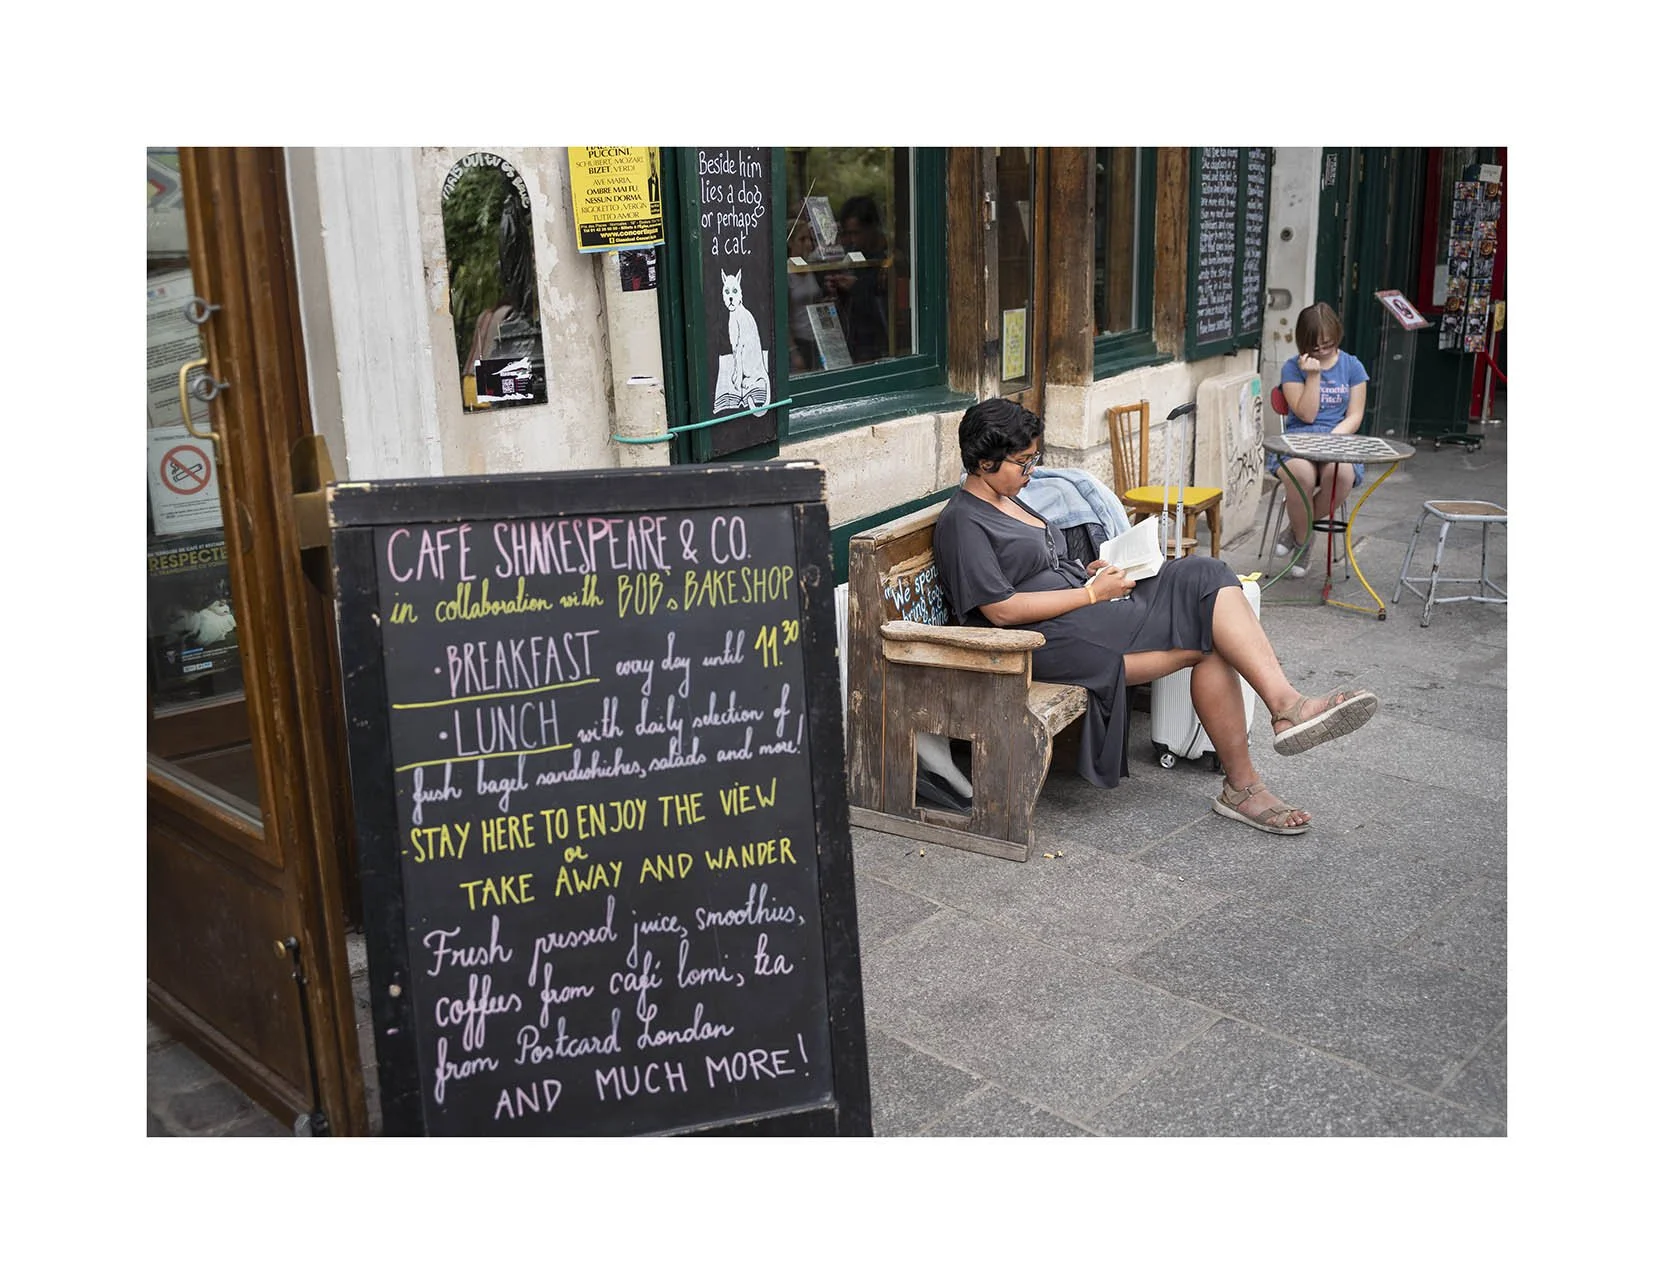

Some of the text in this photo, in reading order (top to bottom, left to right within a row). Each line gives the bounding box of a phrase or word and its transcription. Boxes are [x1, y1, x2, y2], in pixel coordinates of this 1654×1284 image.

[586, 187, 611, 196] OMBRE
[699, 150, 763, 178] Beside him
[585, 196, 612, 205] NESSUN
[701, 177, 765, 219] lies a dog
[701, 205, 758, 236] or perhaps
[711, 230, 752, 256] a cat.
[493, 516, 672, 578] SHAKESPEARE
[679, 518, 699, 564] &
[711, 516, 752, 564] CO.
[390, 591, 418, 624] in
[435, 575, 553, 622] collaboration
[560, 573, 604, 609] with
[914, 565, 939, 595] spen
[446, 630, 600, 698] BREAKFAST
[616, 658, 654, 696] every
[661, 632, 691, 698] day
[702, 630, 745, 667] until
[454, 683, 791, 756] LUNCH with daily selection of
[412, 761, 462, 826] fresh
[477, 752, 529, 813] bagel
[648, 736, 707, 772] salads
[717, 726, 753, 762] and
[759, 713, 804, 755] more!
[410, 821, 470, 863] STAY
[481, 813, 535, 854] HERE
[540, 807, 569, 844] TO
[576, 797, 647, 840] ENJOY
[658, 792, 706, 828] THE
[564, 845, 589, 864] or
[459, 837, 797, 911] TAKE AWAY AND WANDER
[423, 882, 805, 987] Fresh pressed juice, smoothies,
[435, 932, 794, 1051] coffees from café lomi, tea
[434, 1002, 735, 1104] from Postcard London
[494, 1033, 809, 1120] AND MUCH MORE!
